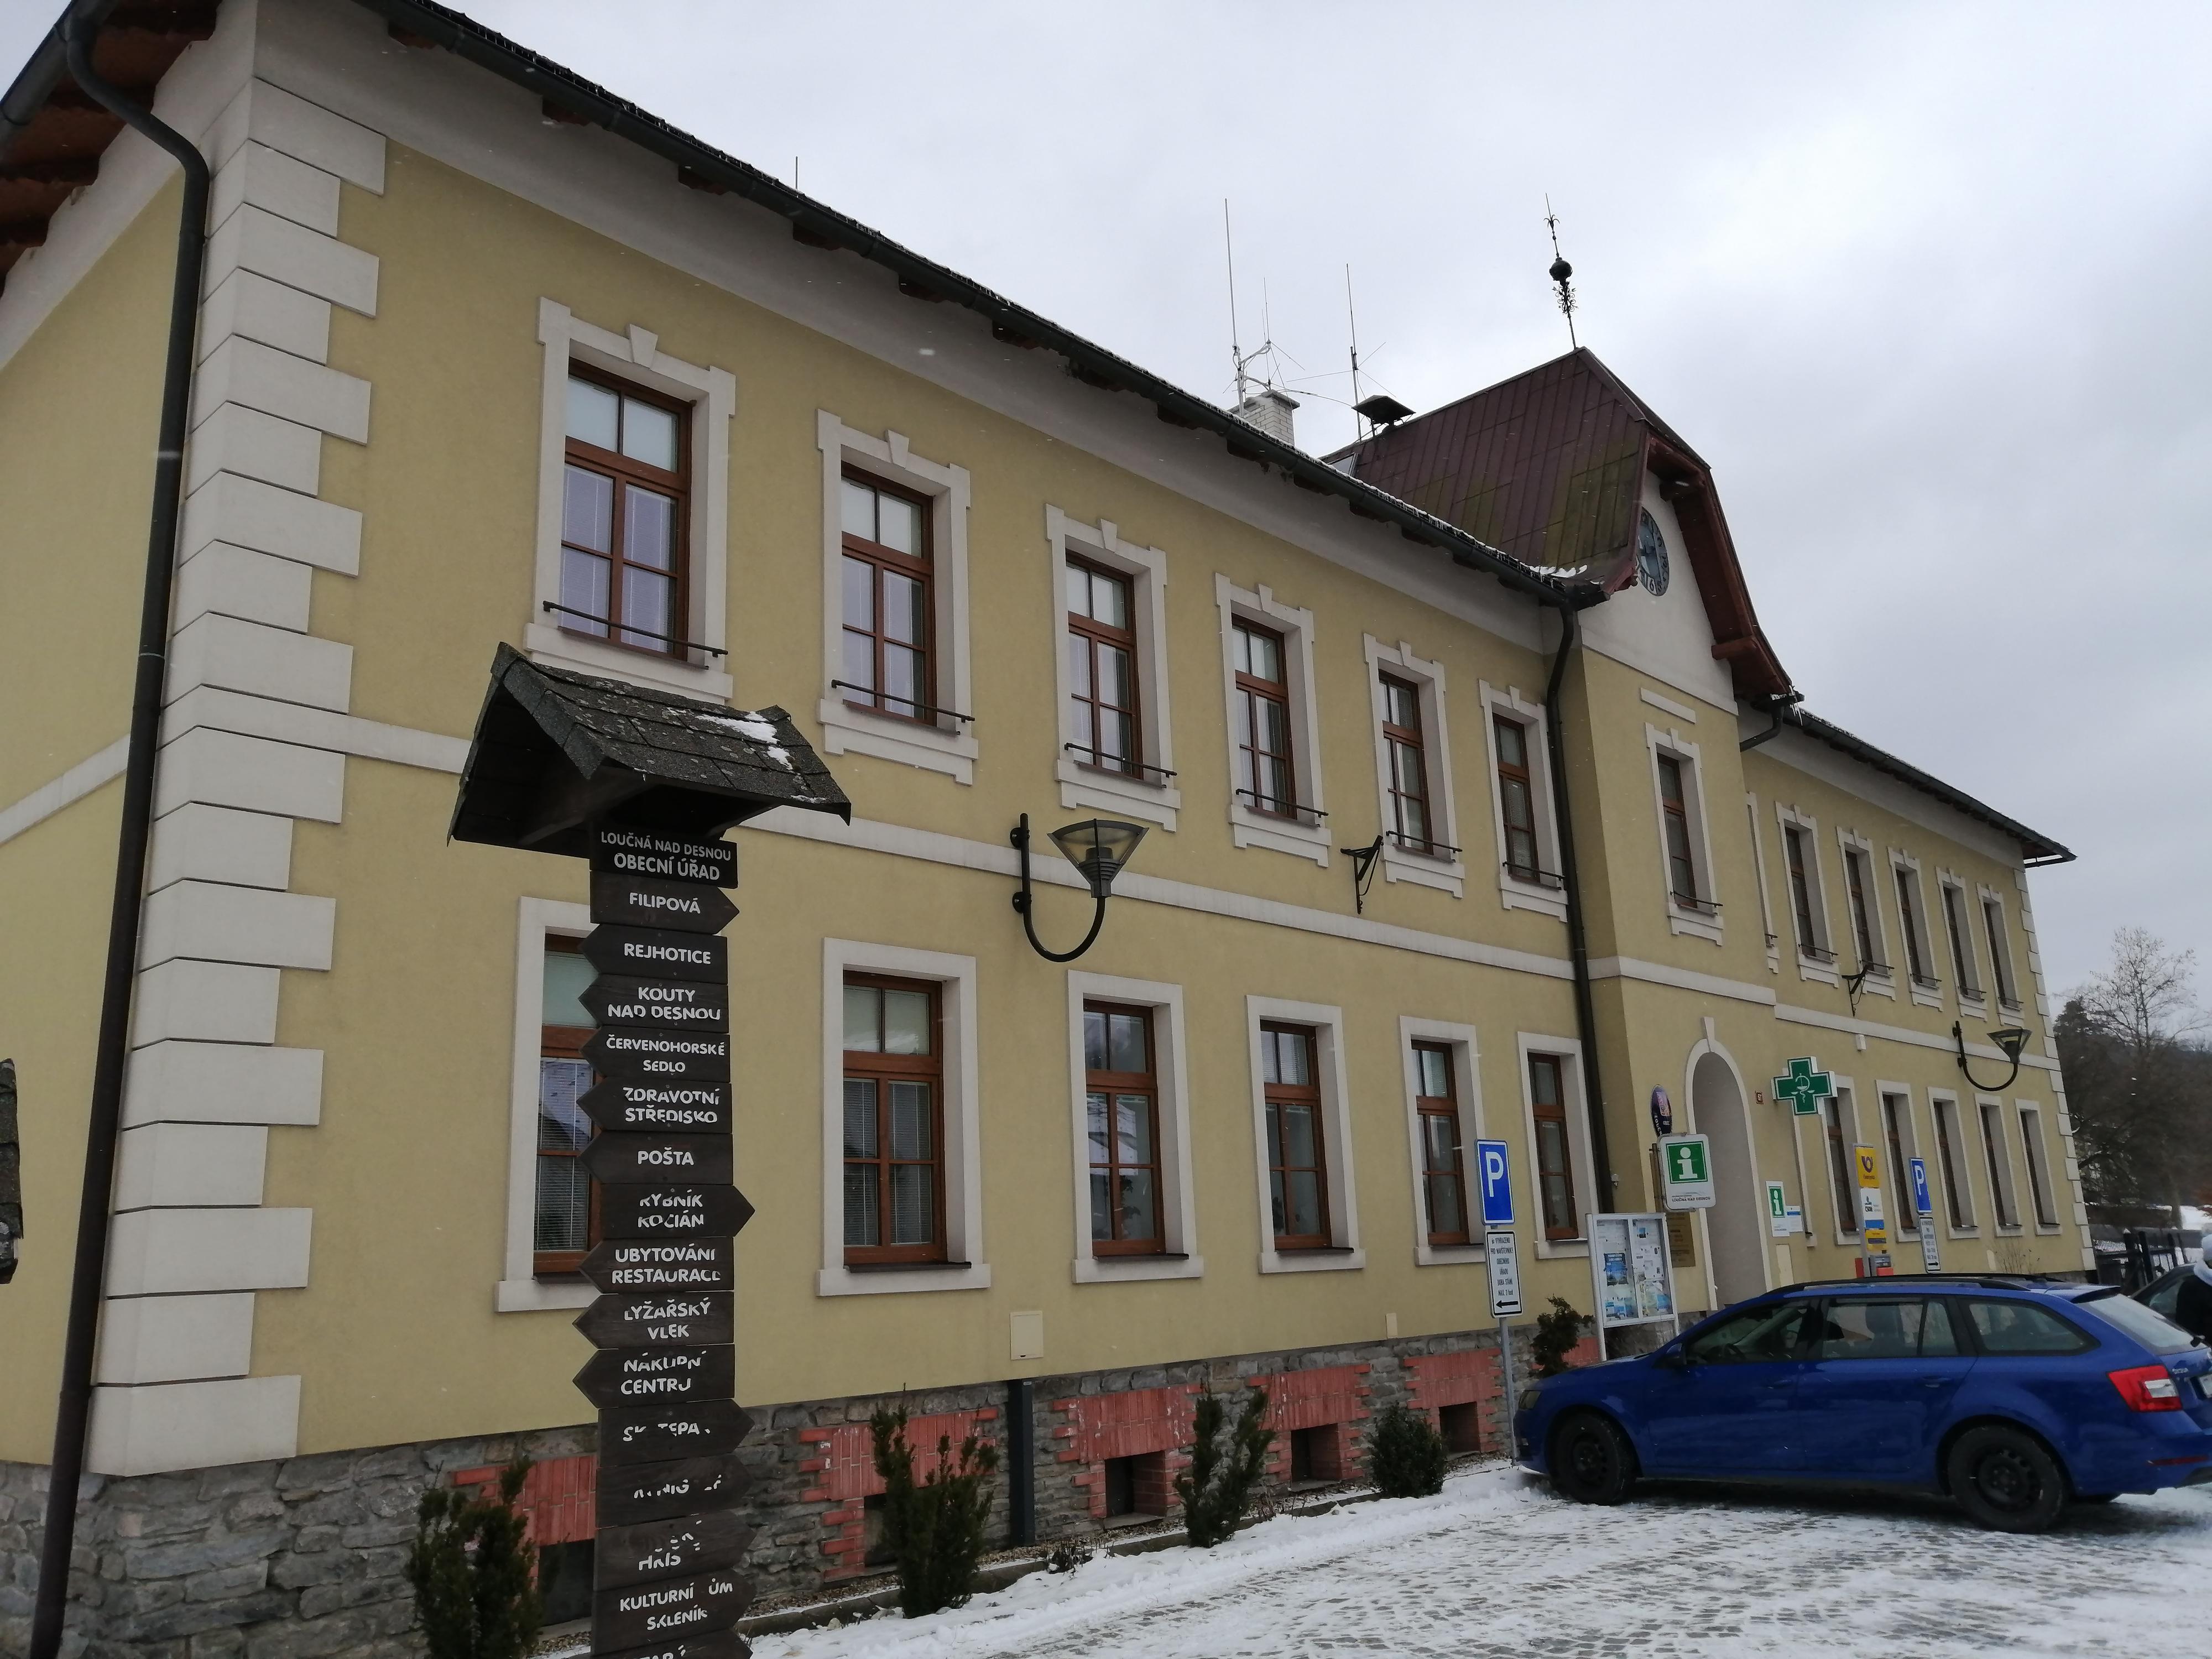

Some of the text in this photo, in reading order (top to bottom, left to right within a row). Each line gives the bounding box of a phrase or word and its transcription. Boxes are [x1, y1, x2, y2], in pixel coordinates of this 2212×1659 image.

[601, 831, 731, 861] LOUČNÁ NAD DESNOU
[614, 852, 720, 880] OBECNÍ ÚŘAD
[629, 892, 701, 914] FILIPOVÁ
[624, 943, 711, 964] REJHOTICE
[638, 987, 696, 1003] KOUTY
[608, 1004, 721, 1020] NAD DESNOU
[606, 1034, 725, 1056] ČERVENOHORSKÉ
[643, 1060, 686, 1073] SEDLO
[623, 1087, 721, 1105] ZDRAVOTNÍ
[625, 1104, 718, 1124] STŘEDISKO
[638, 1147, 694, 1165] POŠTA
[1485, 1151, 1504, 1197] P
[1914, 1165, 1924, 1196] P
[624, 1297, 711, 1321] LYŽAŘSKÝ
[647, 1324, 690, 1340] VLEK
[620, 1582, 694, 1611] KULTURNÍ
[647, 1604, 708, 1630] SKLENÍK
